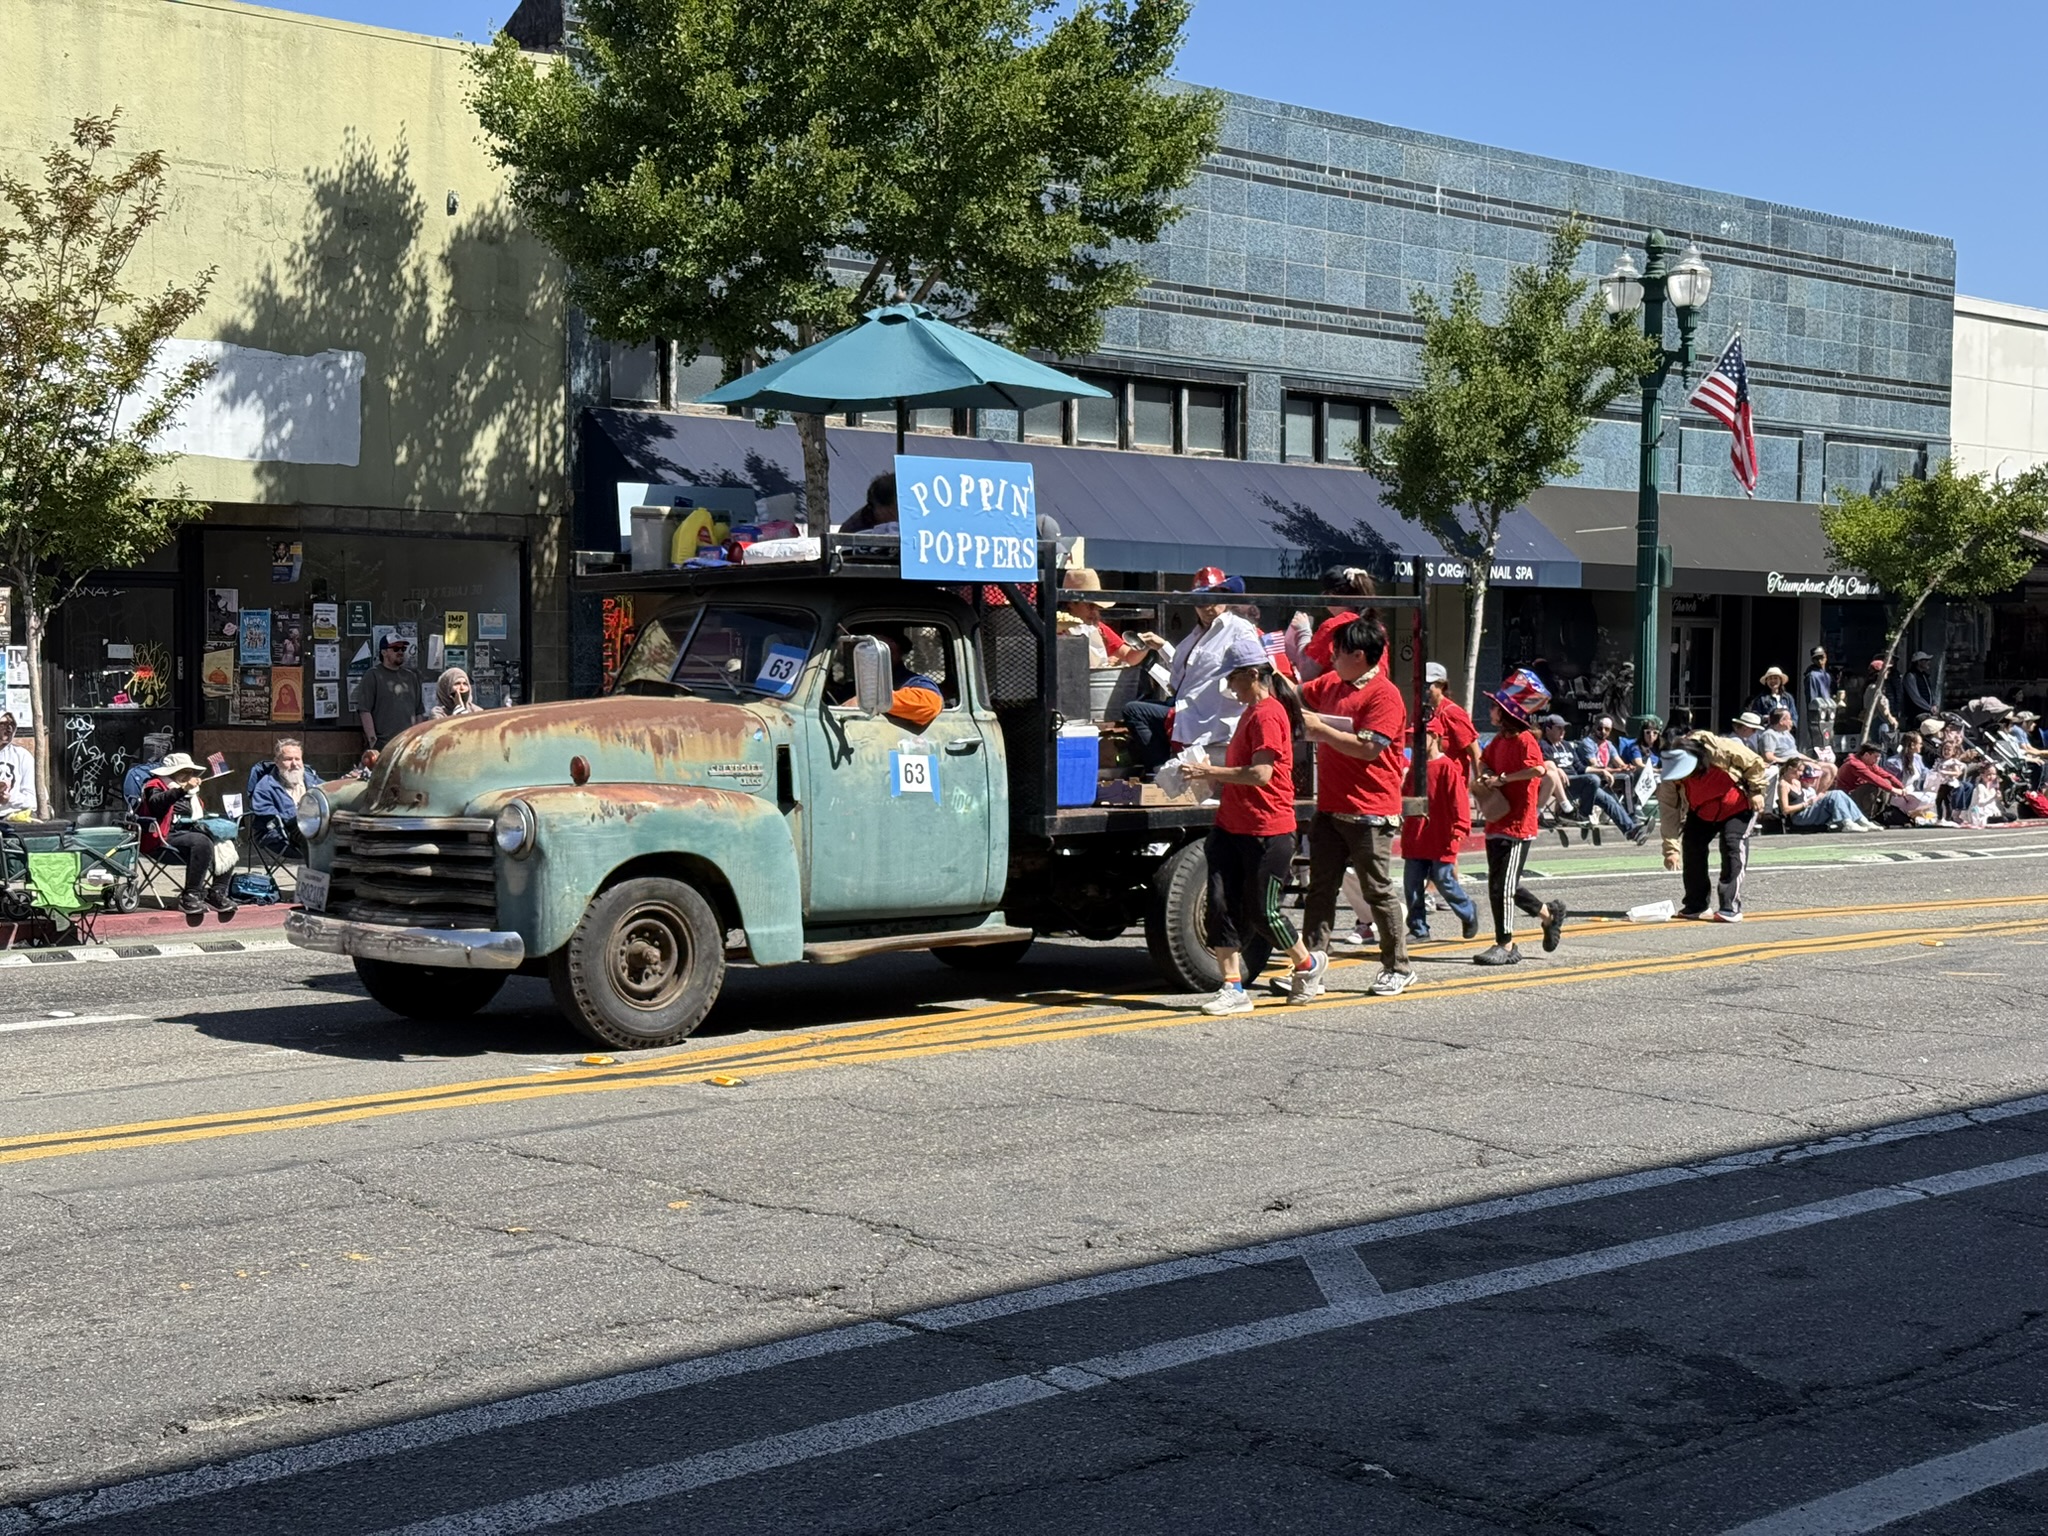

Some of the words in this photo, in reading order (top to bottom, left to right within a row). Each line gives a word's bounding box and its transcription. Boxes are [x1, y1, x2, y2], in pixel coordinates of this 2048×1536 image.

[910, 474, 1033, 518] POPPIN'
[918, 529, 1035, 569] POPPERS
[1394, 562, 1434, 577] TOM'S
[1438, 563, 1473, 579] ORGA
[1490, 566, 1512, 580] NAIL
[1515, 566, 1534, 580] SPA
[1767, 571, 1825, 596] Triumphant
[1825, 575, 1845, 598] Life
[1845, 576, 1880, 596] Church
[448, 614, 465, 622] IMP
[769, 658, 794, 680] 63
[904, 762, 925, 784] 63
